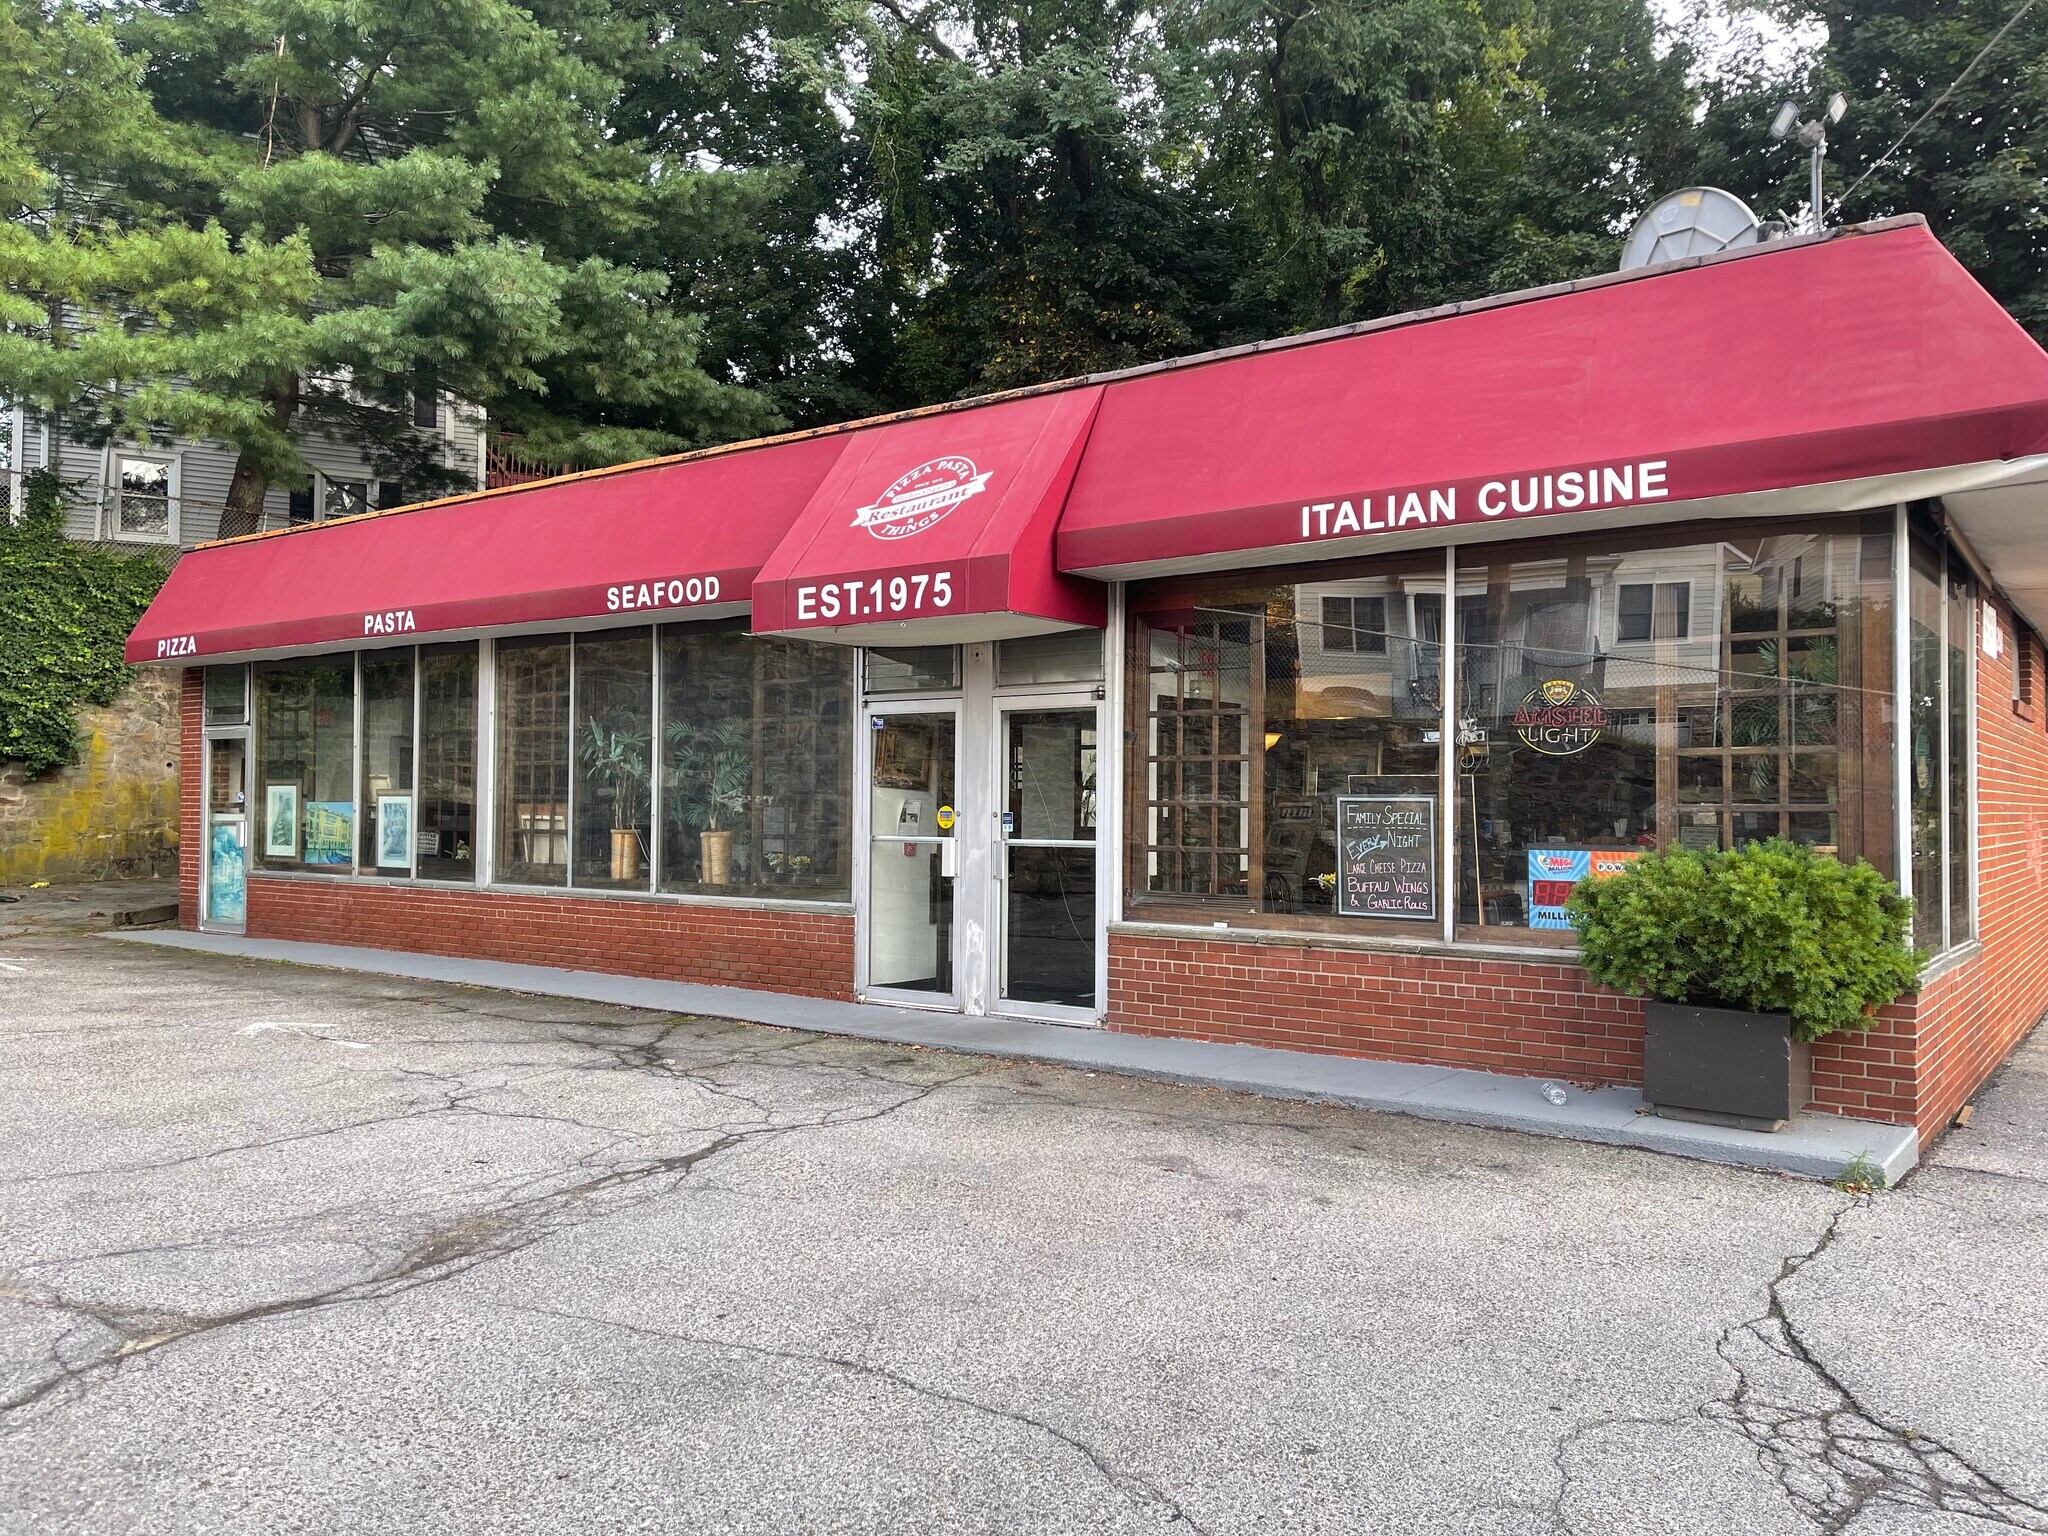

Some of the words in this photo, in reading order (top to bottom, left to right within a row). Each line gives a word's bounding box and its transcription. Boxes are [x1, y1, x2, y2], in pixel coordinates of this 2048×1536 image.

[886, 466, 932, 498] PIZZA
[936, 460, 970, 480] PASTA
[868, 486, 970, 523] Restaurant
[1302, 487, 1457, 537] ITALIAN
[1477, 460, 1669, 516] CUISINE
[881, 511, 940, 536] THINGS
[606, 575, 720, 611] SEAFOOD
[798, 571, 953, 620] EST.1975
[364, 610, 415, 635] PASTA
[157, 635, 196, 657] PIZZA
[1512, 704, 1608, 727] AMSTEL
[1528, 727, 1592, 743] LIGHT
[1549, 857, 1574, 866] MEGA
[1537, 911, 1580, 920] MILLIO
